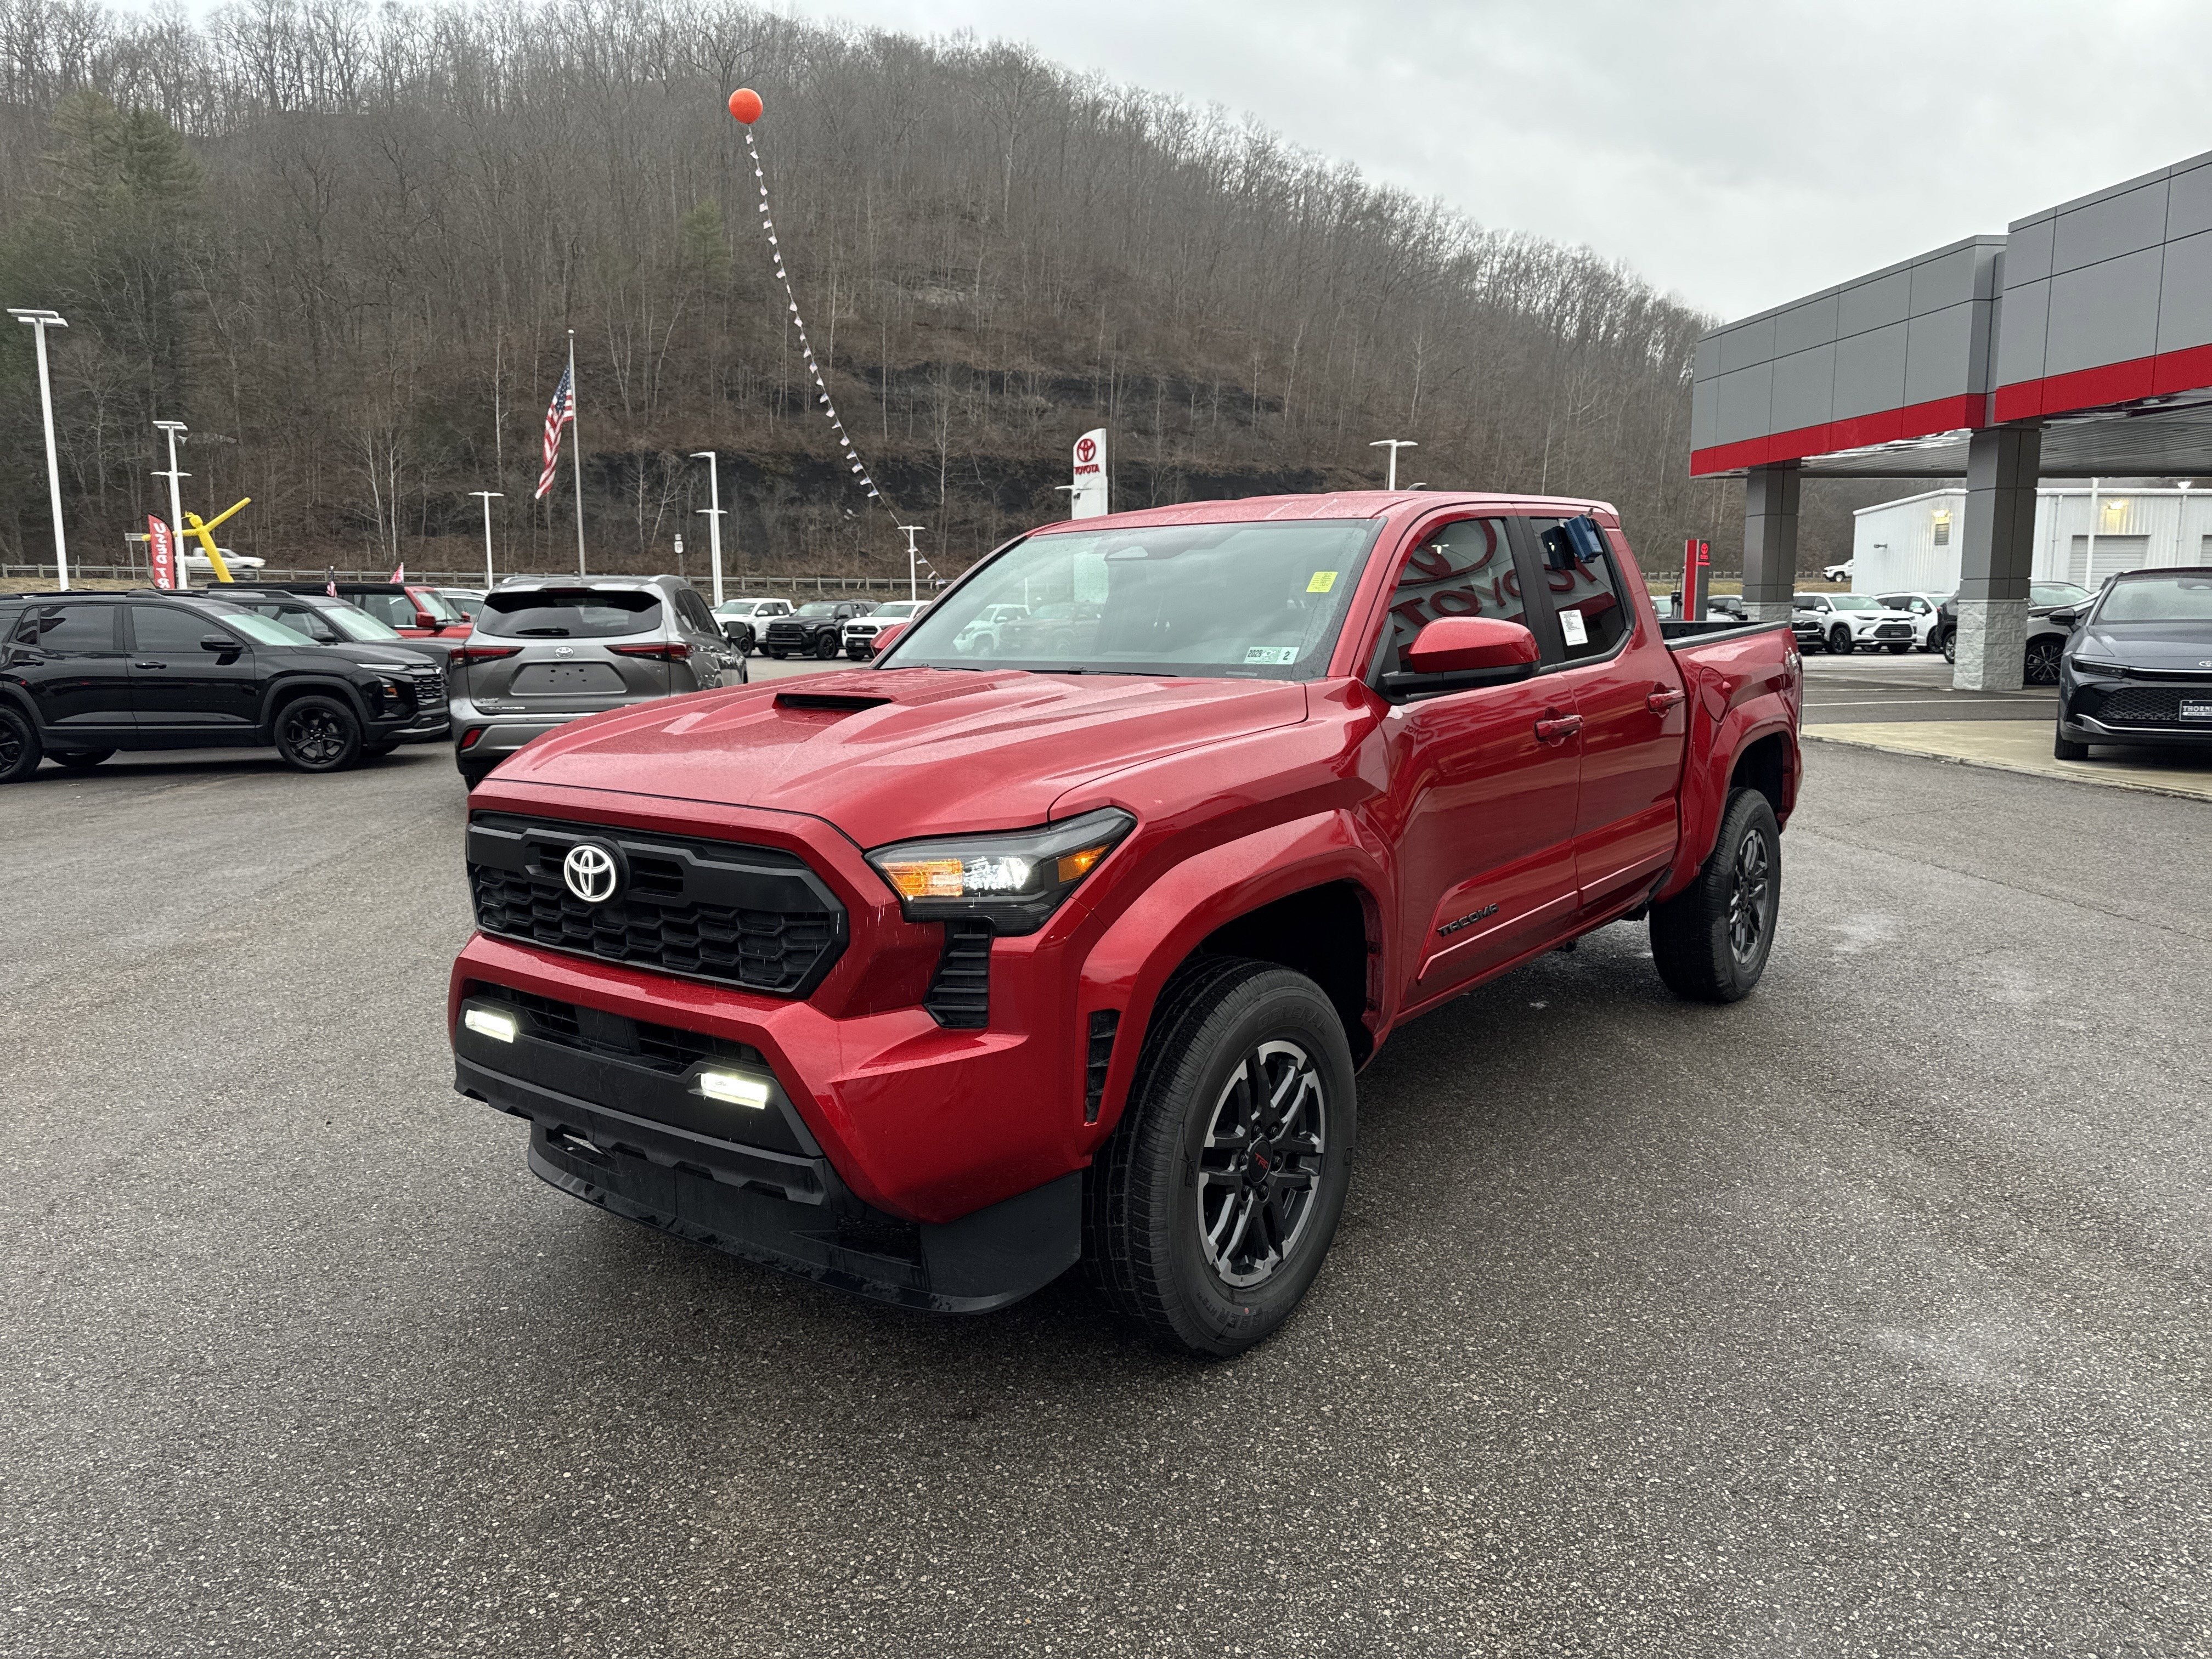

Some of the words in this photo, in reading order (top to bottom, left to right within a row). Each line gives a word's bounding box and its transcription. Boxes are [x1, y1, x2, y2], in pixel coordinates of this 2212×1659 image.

[1073, 464, 1100, 475] TOYOTA
[1283, 651, 1290, 660] 2
[1436, 903, 1499, 938] TACOMA
[1257, 1005, 1327, 1035] GENERAL
[1255, 1152, 1269, 1169] TRD
